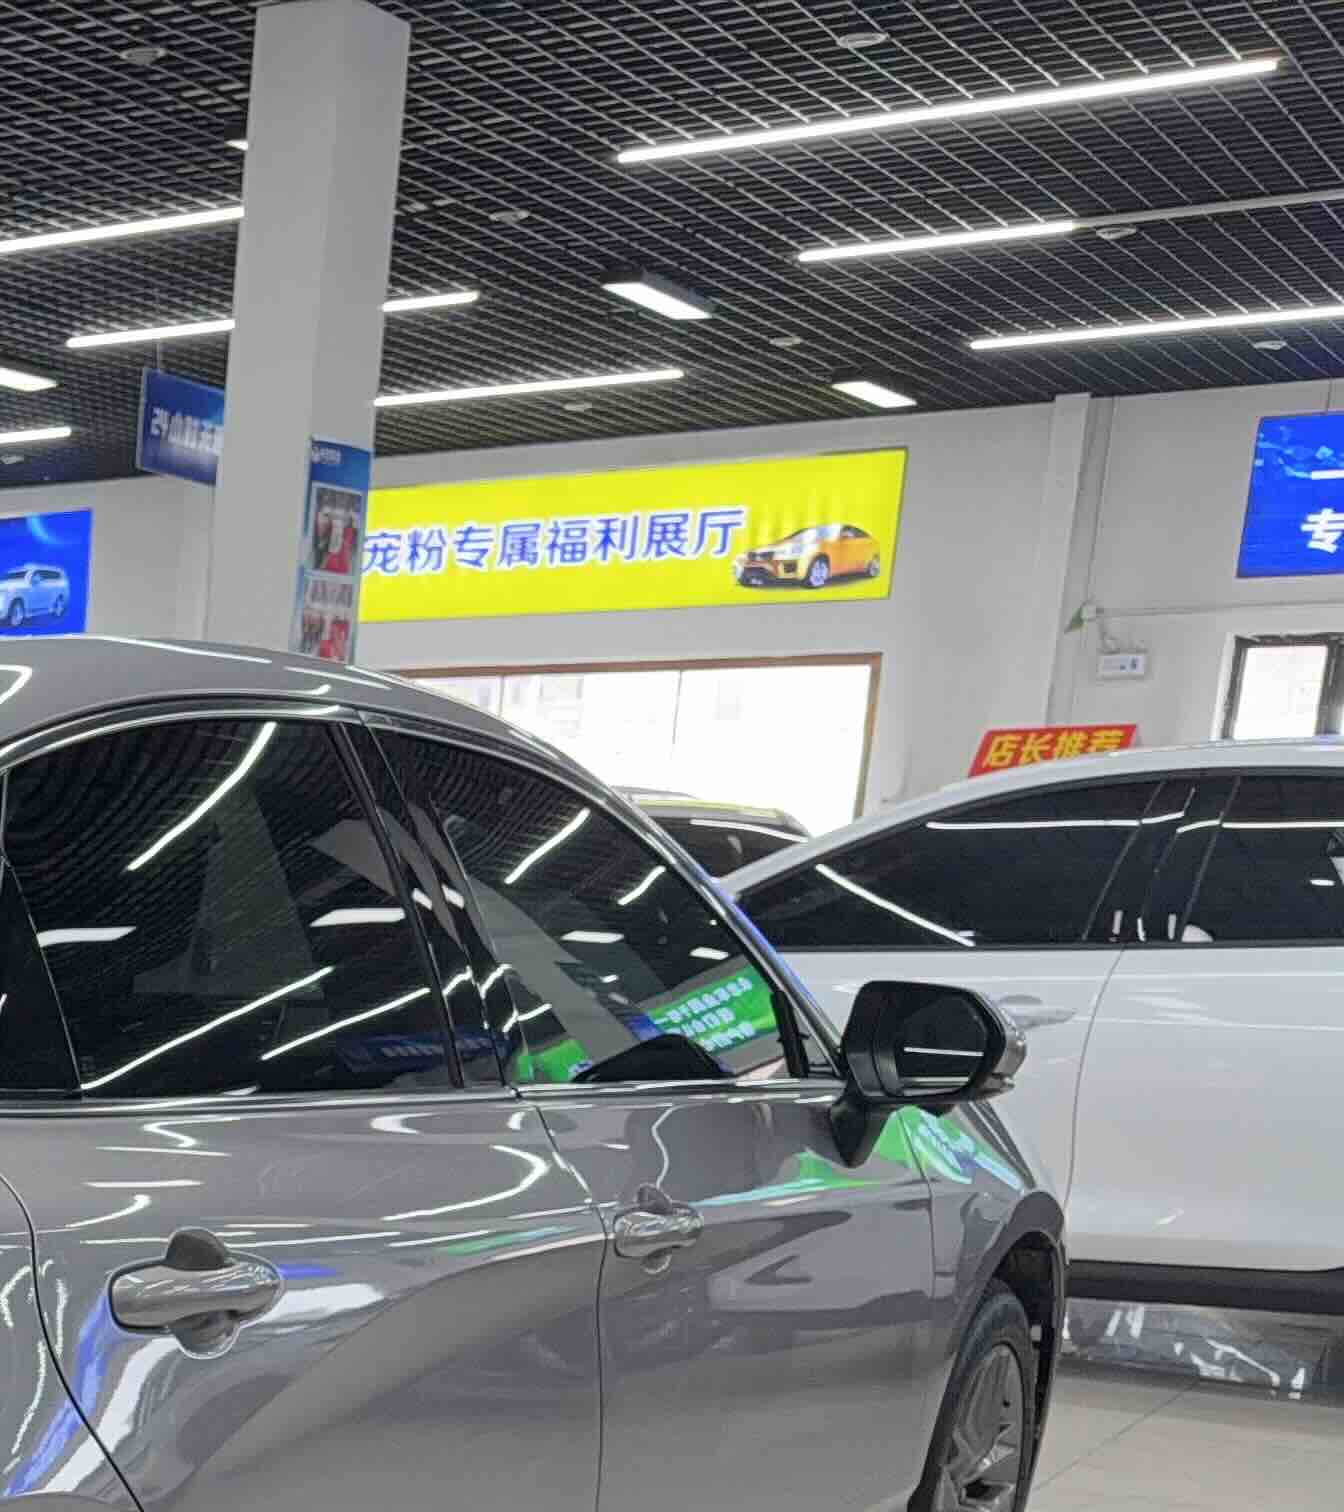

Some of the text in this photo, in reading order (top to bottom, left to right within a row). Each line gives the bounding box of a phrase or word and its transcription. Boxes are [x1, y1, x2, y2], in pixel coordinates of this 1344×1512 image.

[362, 508, 745, 574] 宠粉专属福利展厅
